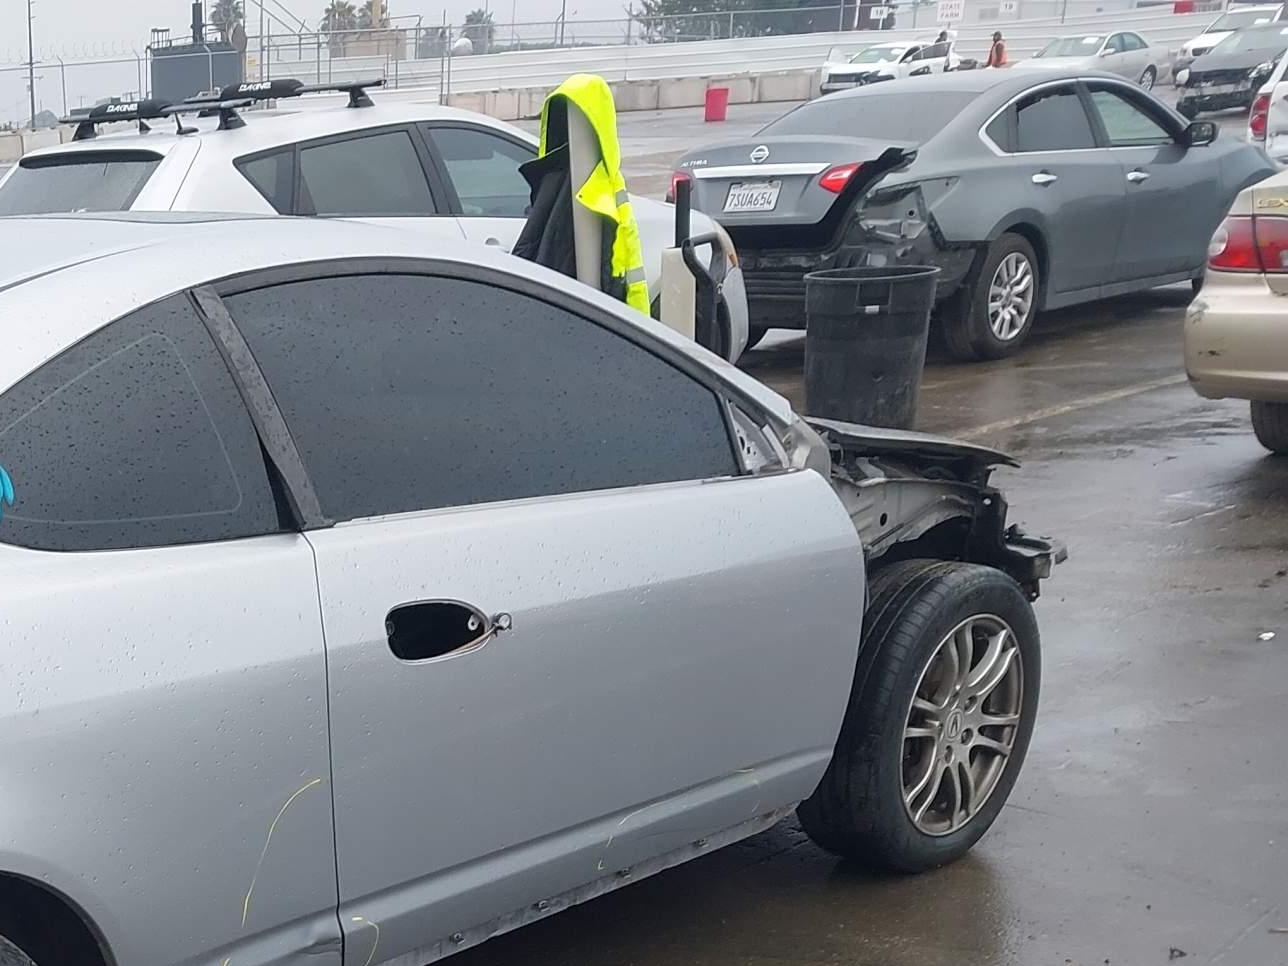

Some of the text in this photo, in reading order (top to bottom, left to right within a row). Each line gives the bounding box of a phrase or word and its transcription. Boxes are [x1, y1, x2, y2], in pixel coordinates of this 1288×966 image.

[238, 82, 272, 92] DAKINE
[106, 103, 138, 113] DAKINE
[680, 160, 708, 168] ALTIMA
[728, 191, 773, 208] 7SUA654
